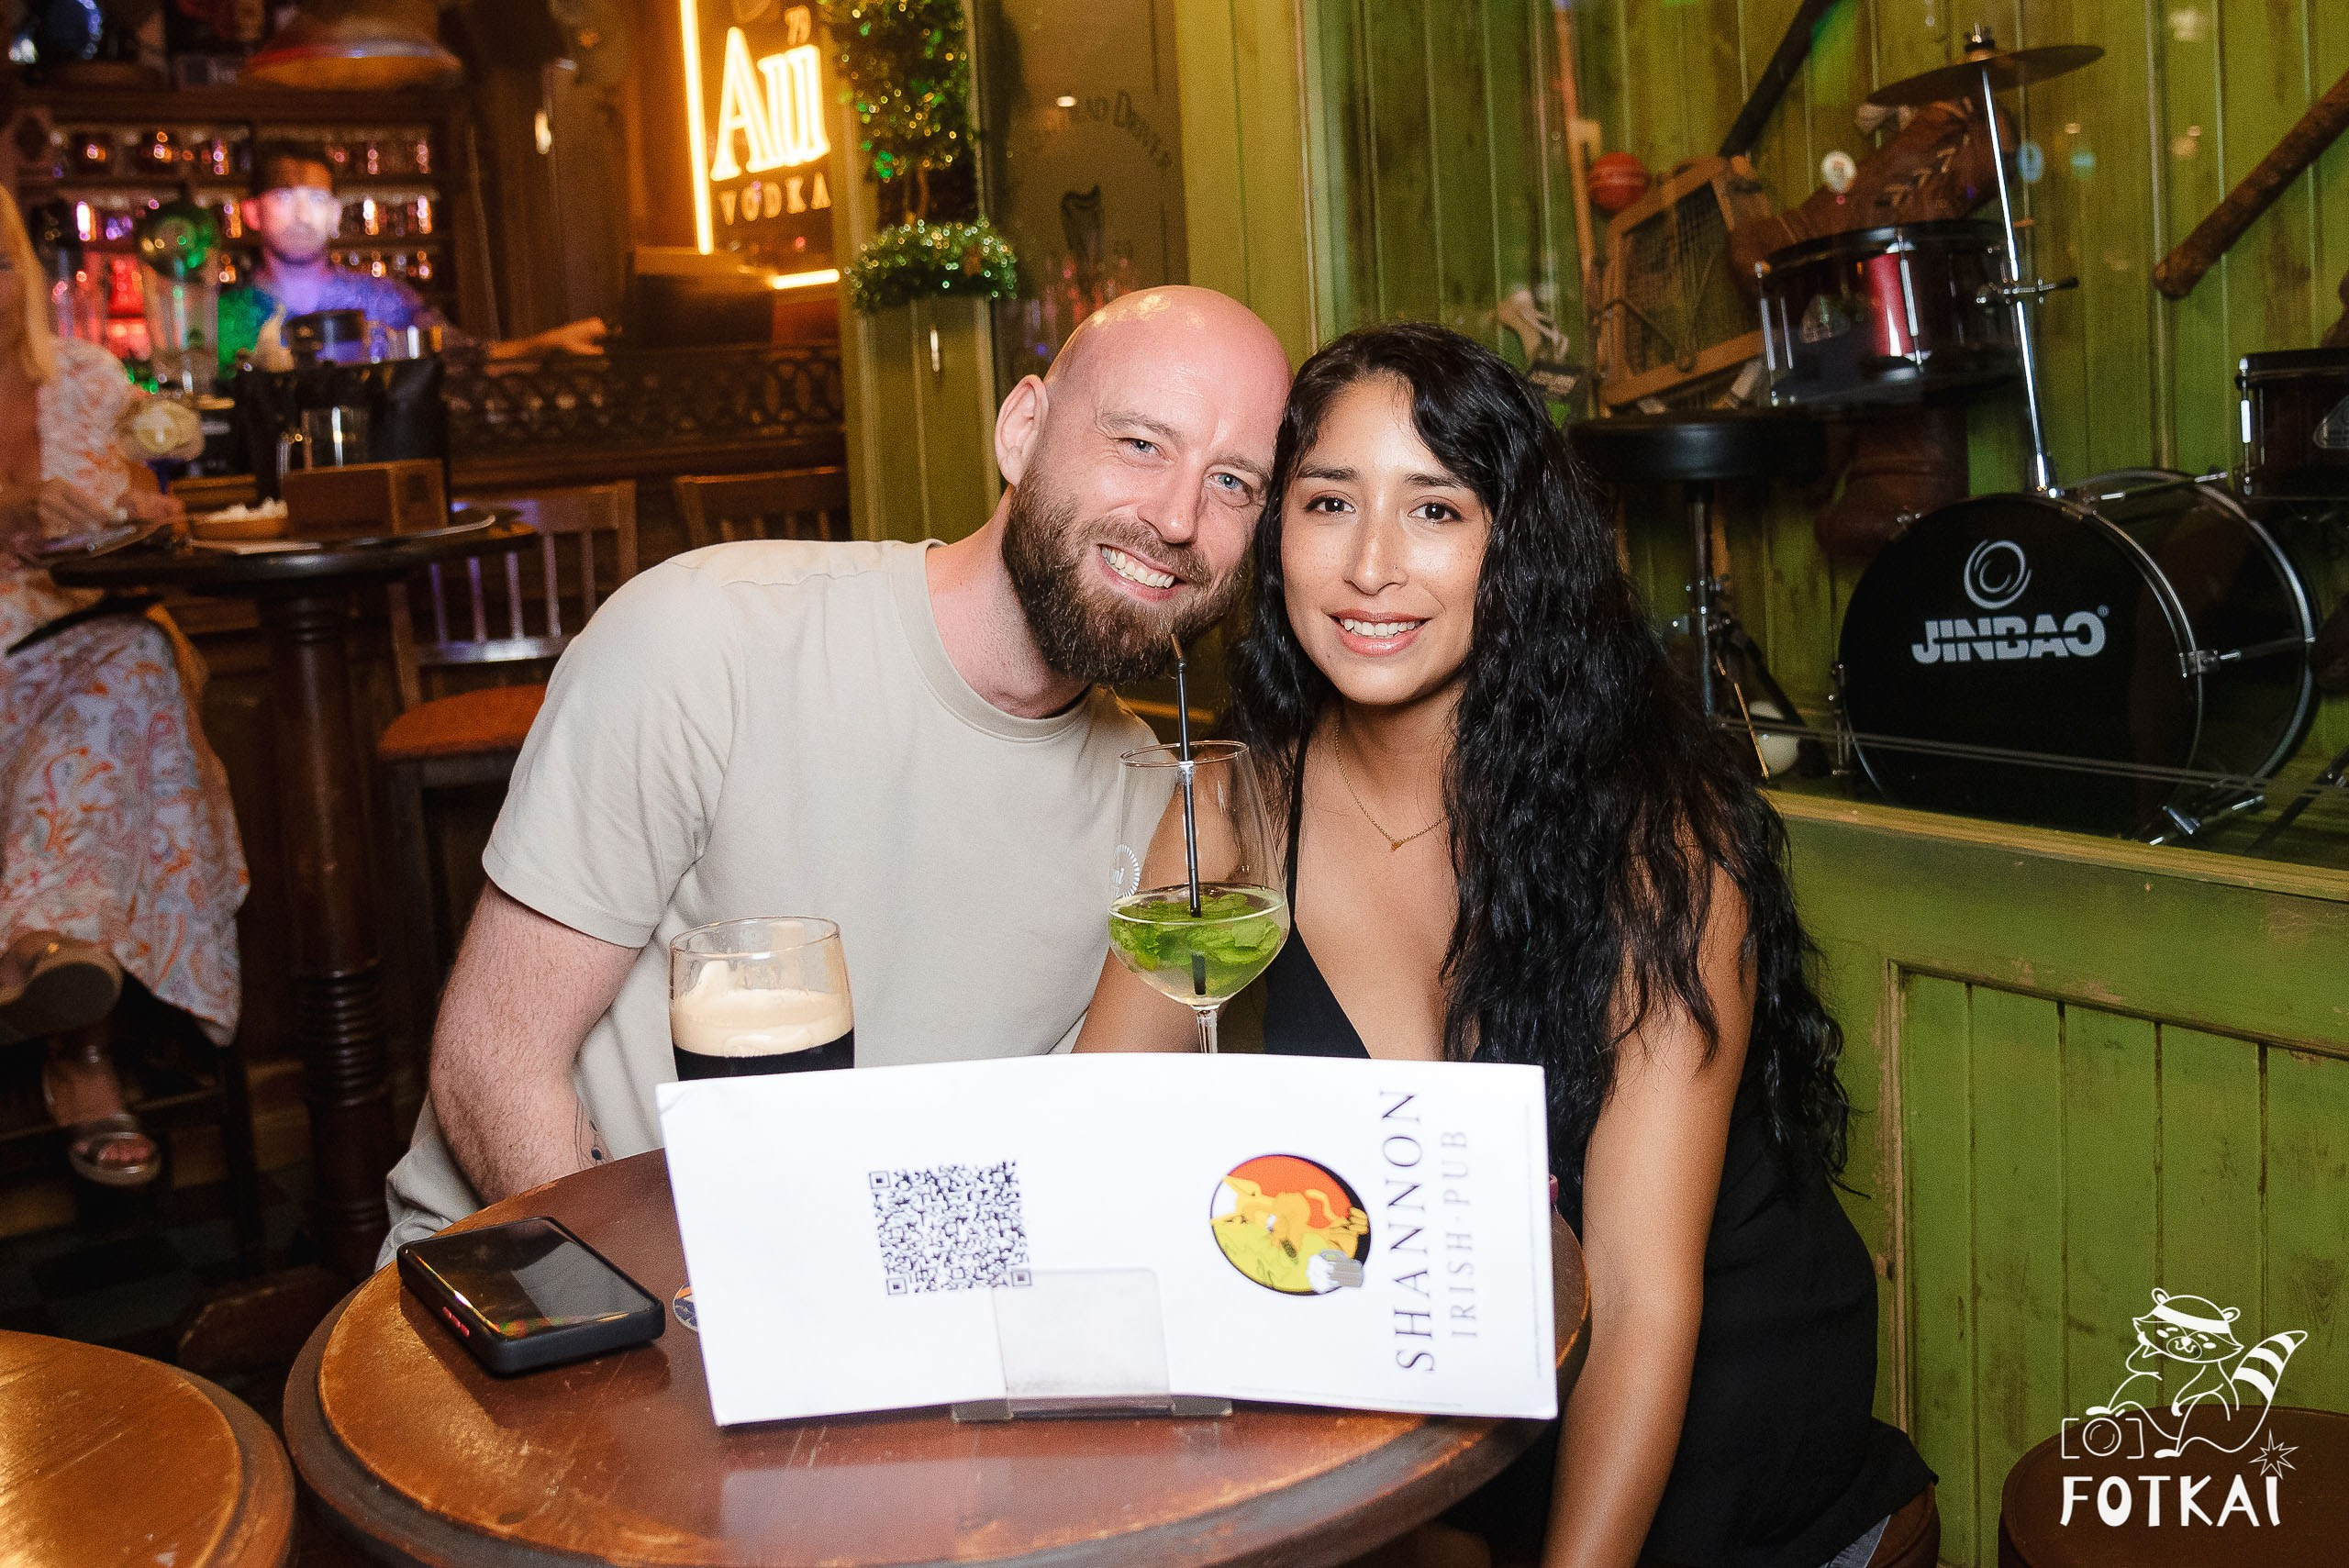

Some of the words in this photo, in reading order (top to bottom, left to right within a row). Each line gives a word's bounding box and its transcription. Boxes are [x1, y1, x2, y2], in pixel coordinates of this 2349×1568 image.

[718, 172, 831, 226] VODKA
[1911, 611, 2106, 664] JINBAO
[1379, 1089, 1436, 1373] SHANNON
